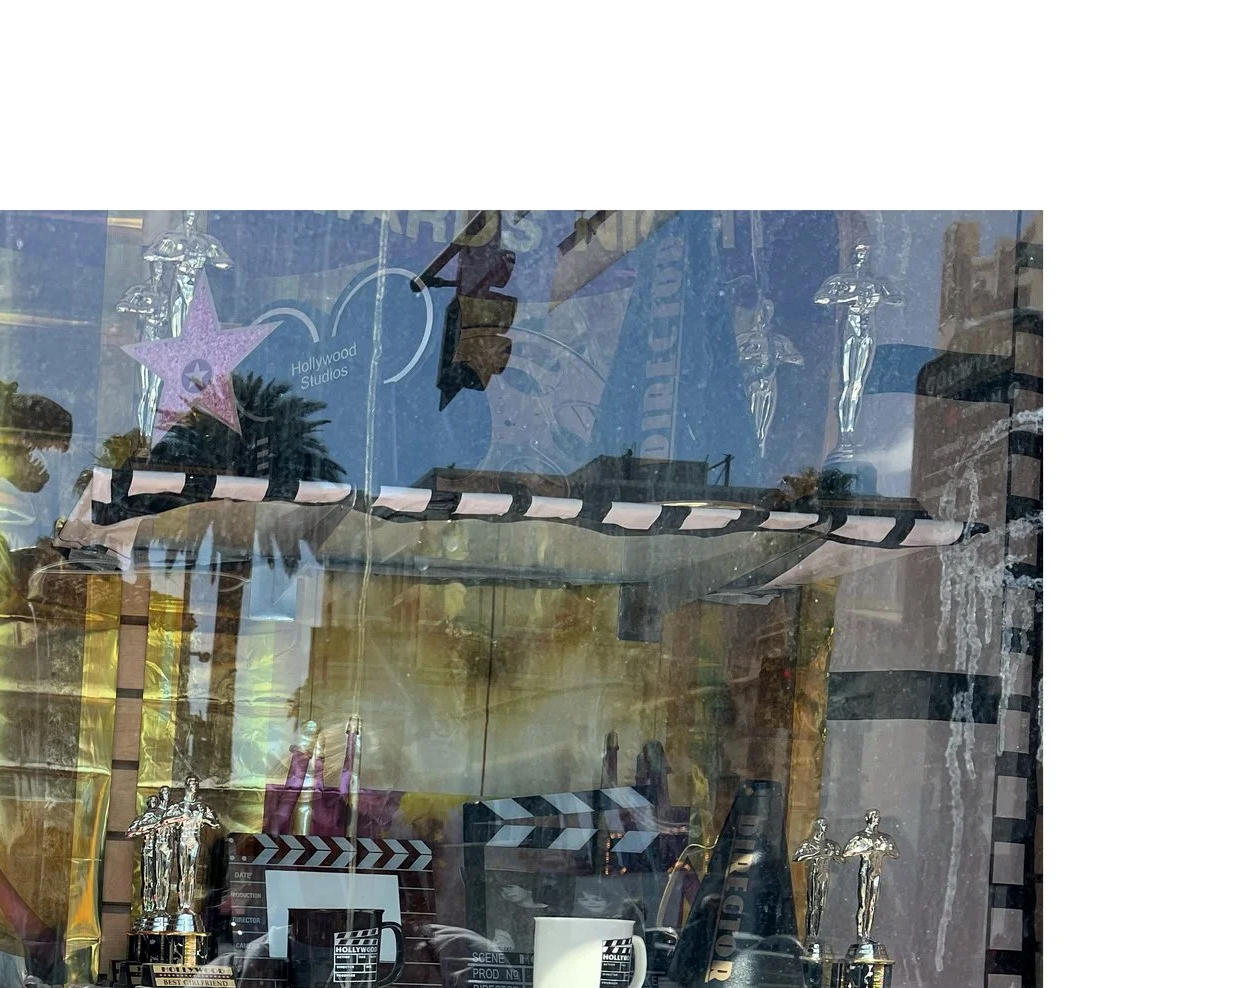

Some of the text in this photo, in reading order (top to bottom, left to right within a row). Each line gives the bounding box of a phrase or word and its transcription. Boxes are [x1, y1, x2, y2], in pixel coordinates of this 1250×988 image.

[291, 341, 357, 376] Hollywood
[300, 366, 348, 390] Studios
[708, 815, 759, 982] DIRECTOR
[232, 916, 261, 924] DIRECTOR
[472, 952, 504, 964] SCENE
[161, 966, 226, 974] HOLLYWOOD
[473, 968, 499, 980] PROD
[183, 979, 229, 987] GIRLFRIEND
